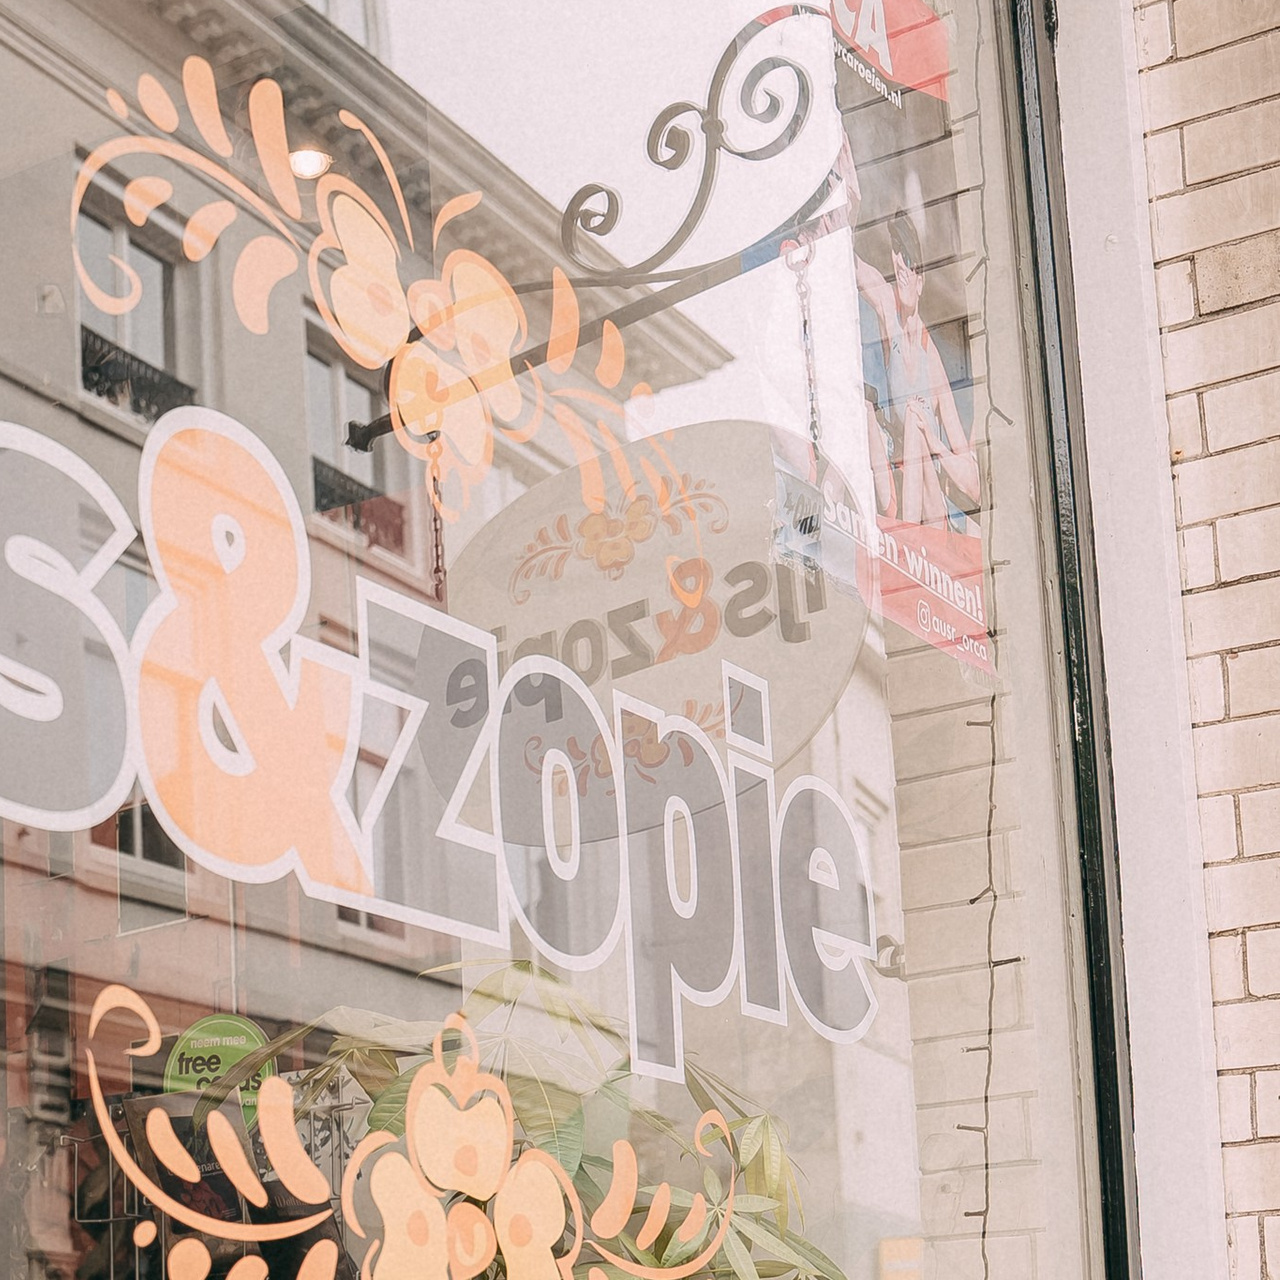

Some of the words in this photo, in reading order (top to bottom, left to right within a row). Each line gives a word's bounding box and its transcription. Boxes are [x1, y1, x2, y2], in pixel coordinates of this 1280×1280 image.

[832, 37, 902, 110] orcaroeien.nl
[904, 544, 984, 622] winnen!
[178, 1052, 221, 1076] free
[190, 1038, 220, 1049] neem
[222, 1035, 247, 1046] mee
